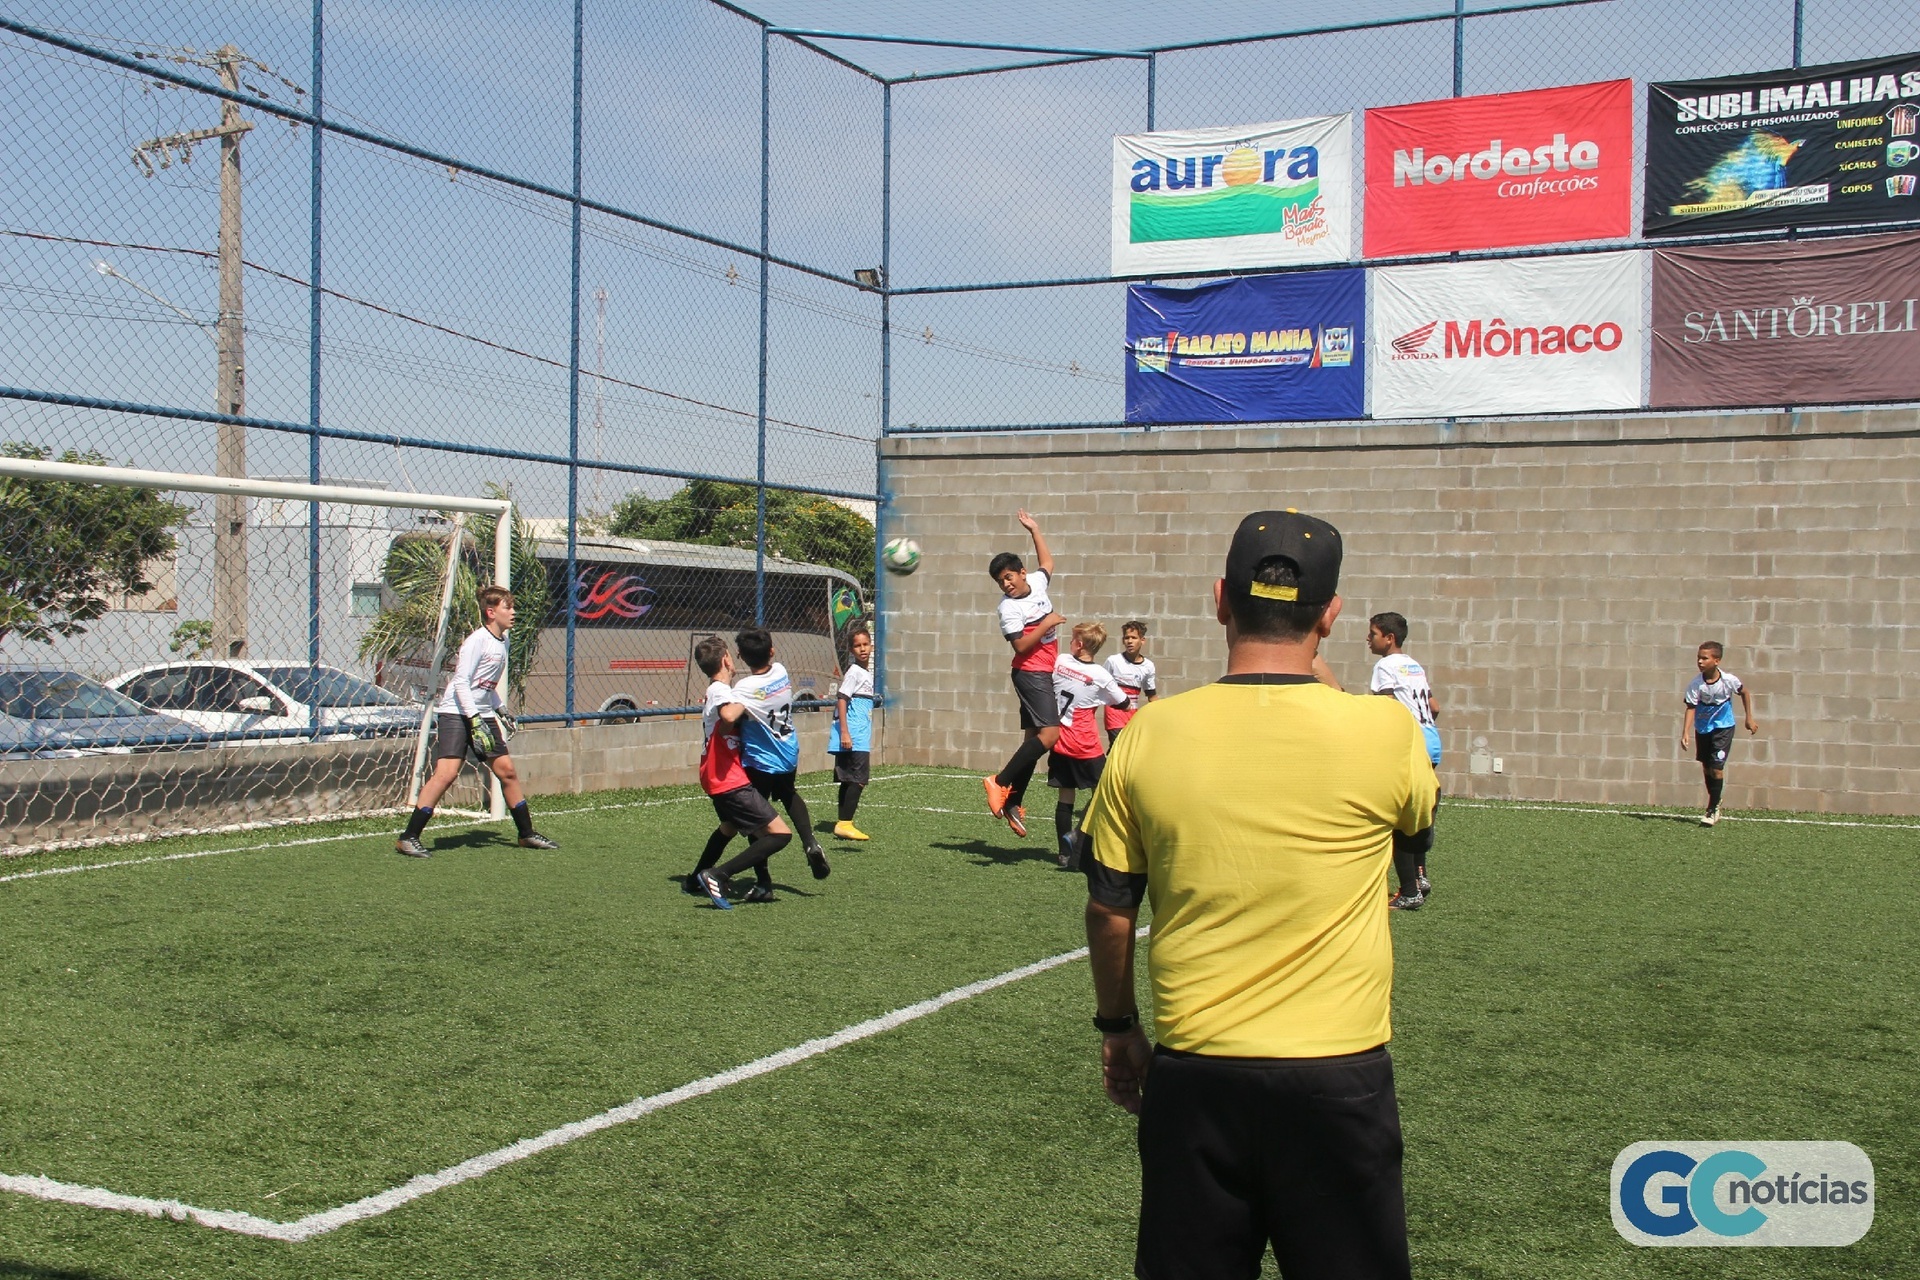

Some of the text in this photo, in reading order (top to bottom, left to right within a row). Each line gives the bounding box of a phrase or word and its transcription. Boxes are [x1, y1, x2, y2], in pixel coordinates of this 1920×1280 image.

[1676, 71, 1920, 123] SUBLIMALHAS
[1742, 119, 1748, 129] E
[1750, 110, 1840, 128] PERSONALIZADOS
[1836, 115, 1884, 130] UNIFORMES
[1225, 138, 1260, 153] CASA
[1834, 137, 1884, 150] CAMISETAS
[1130, 144, 1320, 193] aurora
[1393, 133, 1600, 188] Nordeste
[1838, 160, 1878, 172] XÍCARAS
[1497, 174, 1599, 200] Confecções
[1840, 183, 1874, 194] COPOS
[1283, 195, 1325, 225] Mais
[1282, 216, 1326, 240] Barato
[1683, 298, 1919, 344] SANTORELI
[1176, 327, 1314, 356] BARATO MANIA
[1325, 327, 1348, 341] TOP
[1444, 318, 1623, 360] Mônaco
[1391, 352, 1439, 361] HONDA
[1060, 689, 1075, 718] 7
